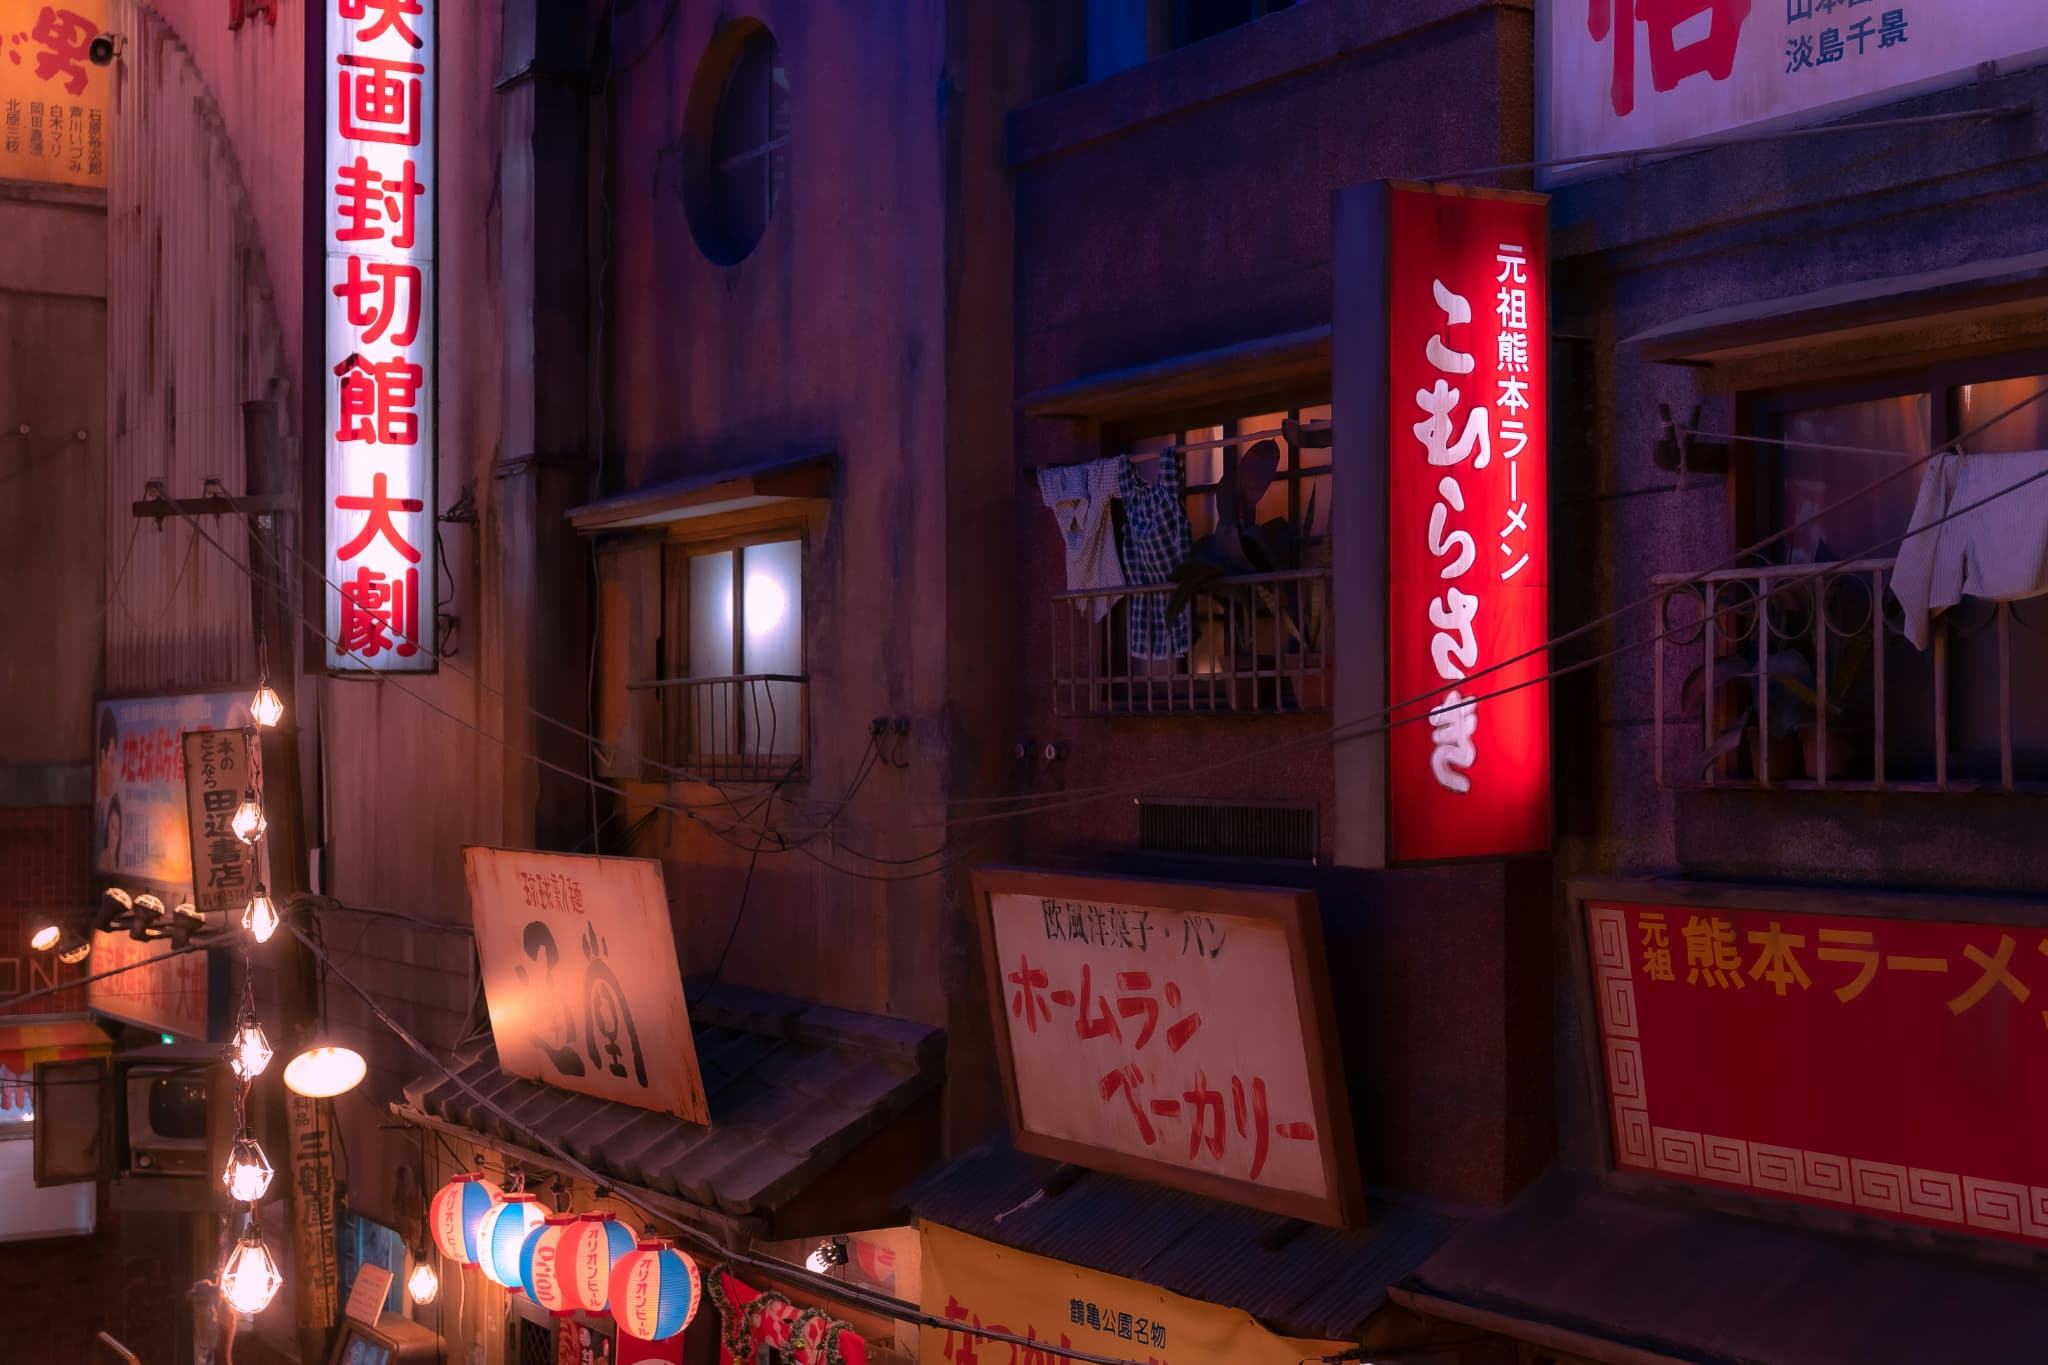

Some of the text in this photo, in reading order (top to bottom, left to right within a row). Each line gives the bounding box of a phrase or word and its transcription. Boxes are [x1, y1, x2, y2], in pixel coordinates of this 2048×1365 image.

[1785, 8, 1908, 73] 淡島千景
[50, 104, 64, 158] 白木マリ
[1496, 244, 1531, 581] 元祖熊本ラーメン
[335, 472, 424, 658] 大劇
[1413, 277, 1491, 793] こむらさき
[218, 738, 235, 771] 本の
[1638, 912, 1676, 981] 元祖
[1681, 914, 2048, 1031] 熊本ラーメ
[1008, 953, 1202, 1053] ホームラン
[1101, 1062, 1315, 1181] ベーカリー
[586, 1229, 600, 1307] オリオンビール
[635, 1258, 652, 1337] オリオンビール
[1070, 1297, 1167, 1350] 鶴亀公園名物
